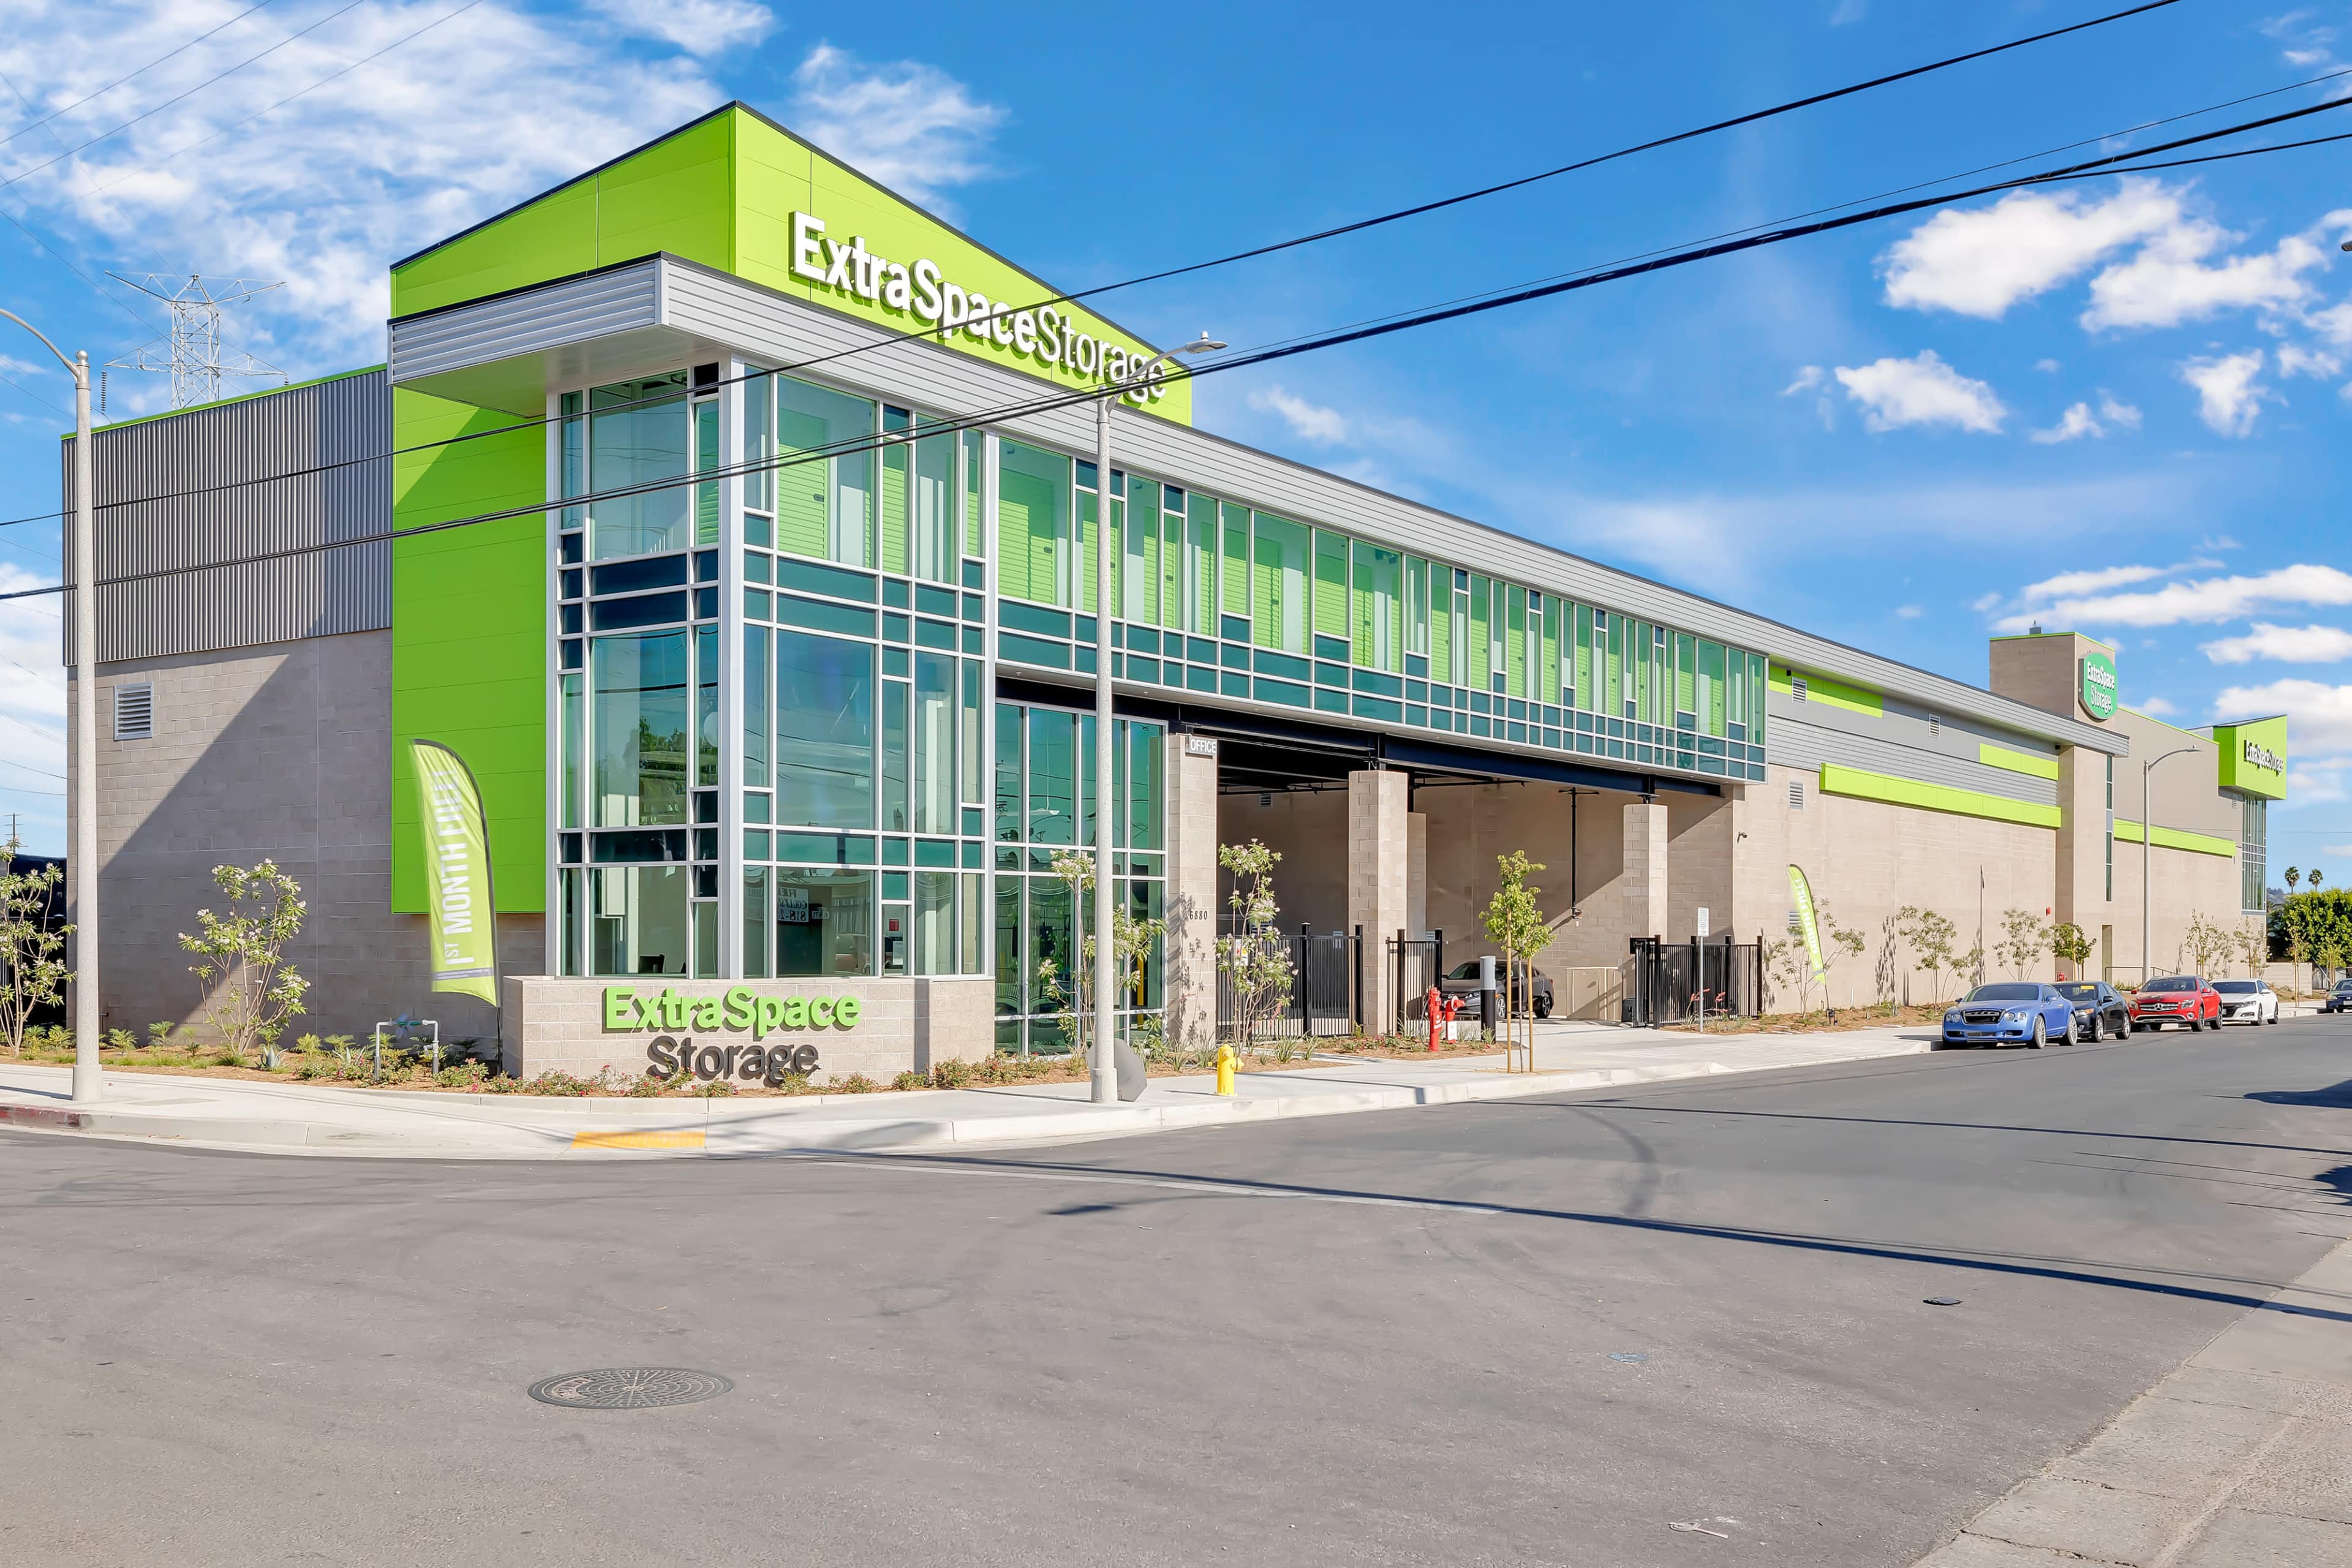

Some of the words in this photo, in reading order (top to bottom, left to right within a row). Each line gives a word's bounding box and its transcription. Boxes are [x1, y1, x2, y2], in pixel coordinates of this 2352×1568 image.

[2087, 661, 2115, 690] ExtraSpace
[2091, 684, 2112, 714] Storage
[1190, 739, 1216, 753] OFFICE
[439, 843, 473, 935] MONTH
[1189, 910, 1208, 920] 6880
[605, 986, 862, 1037] ExtraSpace
[646, 1035, 820, 1085] Storage
